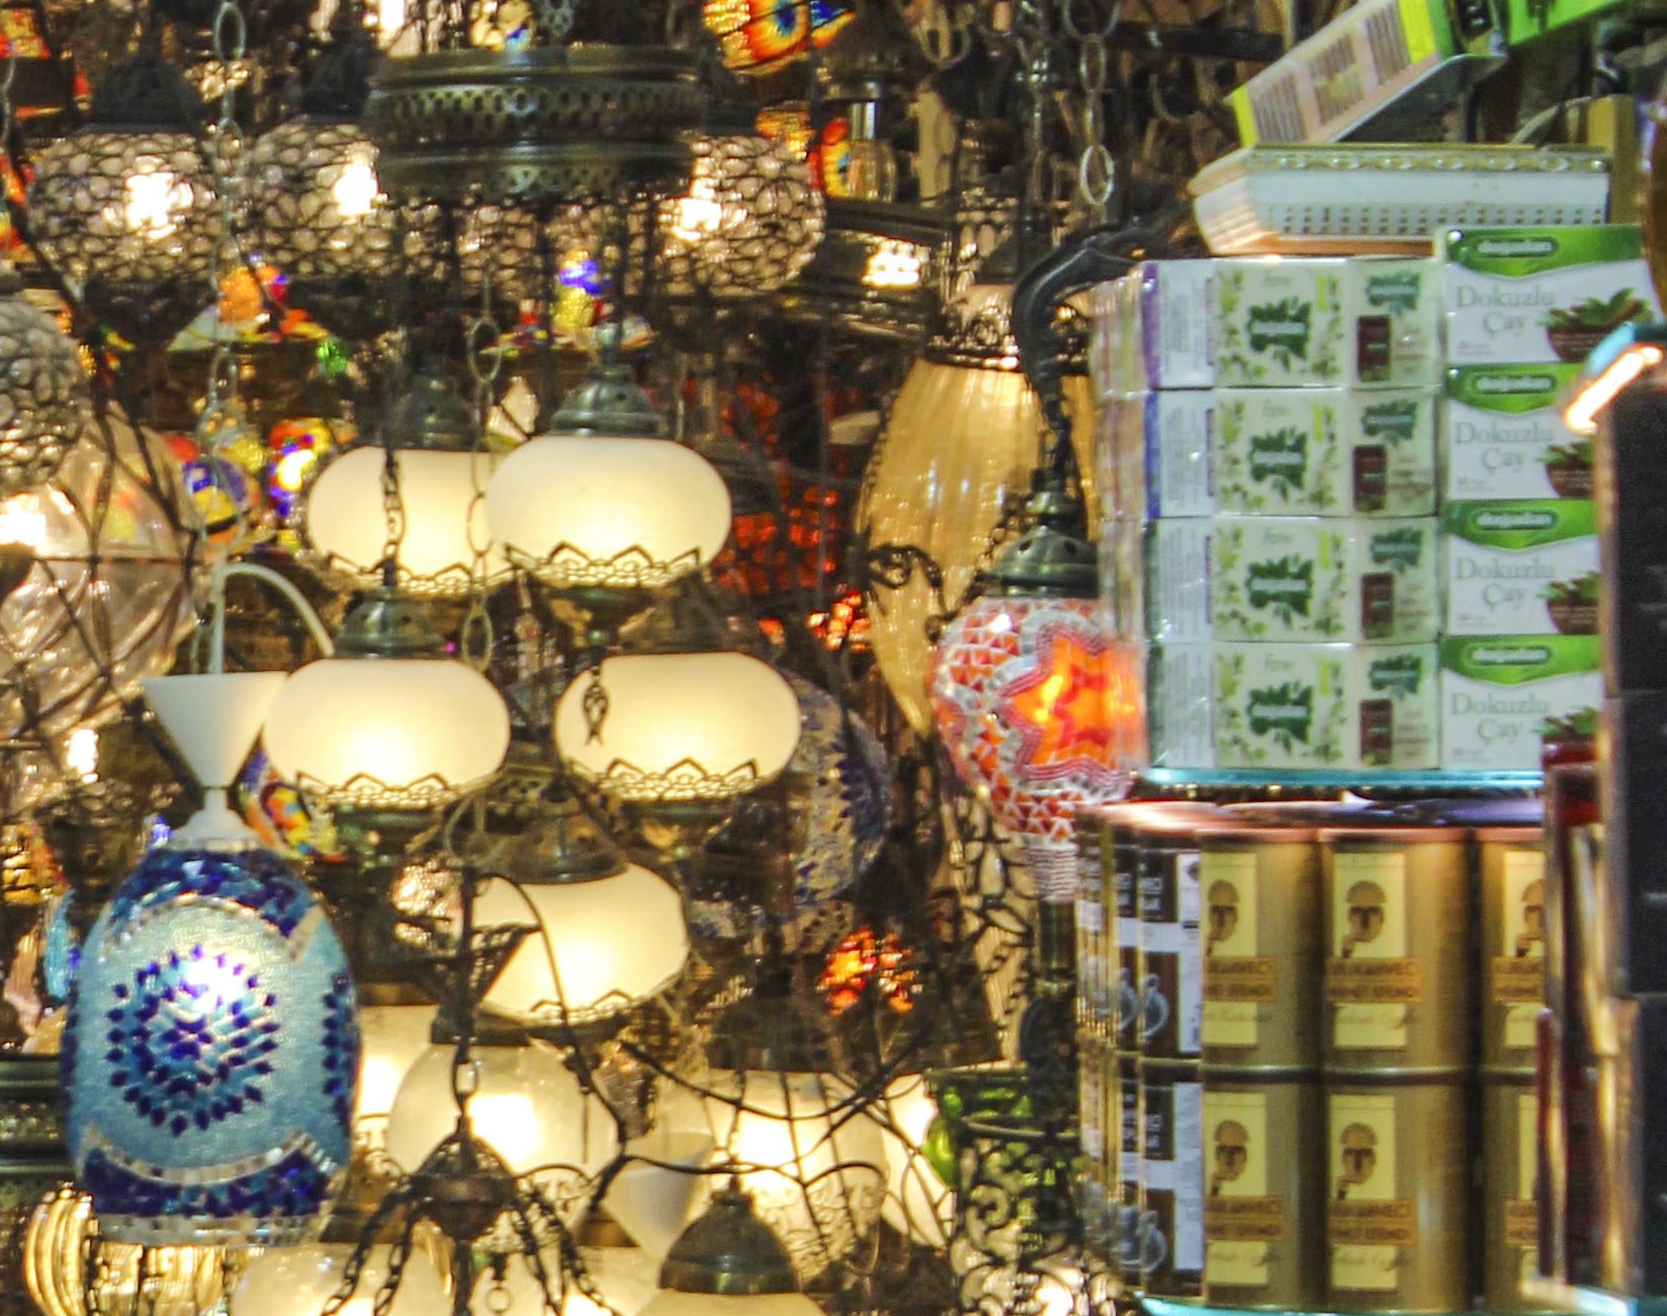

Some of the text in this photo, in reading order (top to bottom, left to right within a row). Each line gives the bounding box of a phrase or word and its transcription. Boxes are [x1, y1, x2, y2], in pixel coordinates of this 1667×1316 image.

[1457, 285, 1555, 308] Dokuzlu
[1484, 311, 1525, 338] Çay
[1457, 422, 1554, 444] Dokuzlu
[1483, 447, 1525, 473] Çay
[1457, 558, 1554, 580] Dokuzlu
[1484, 583, 1525, 610] Çay
[1451, 692, 1549, 715] Dokuzlu
[1478, 719, 1521, 746] Çay
